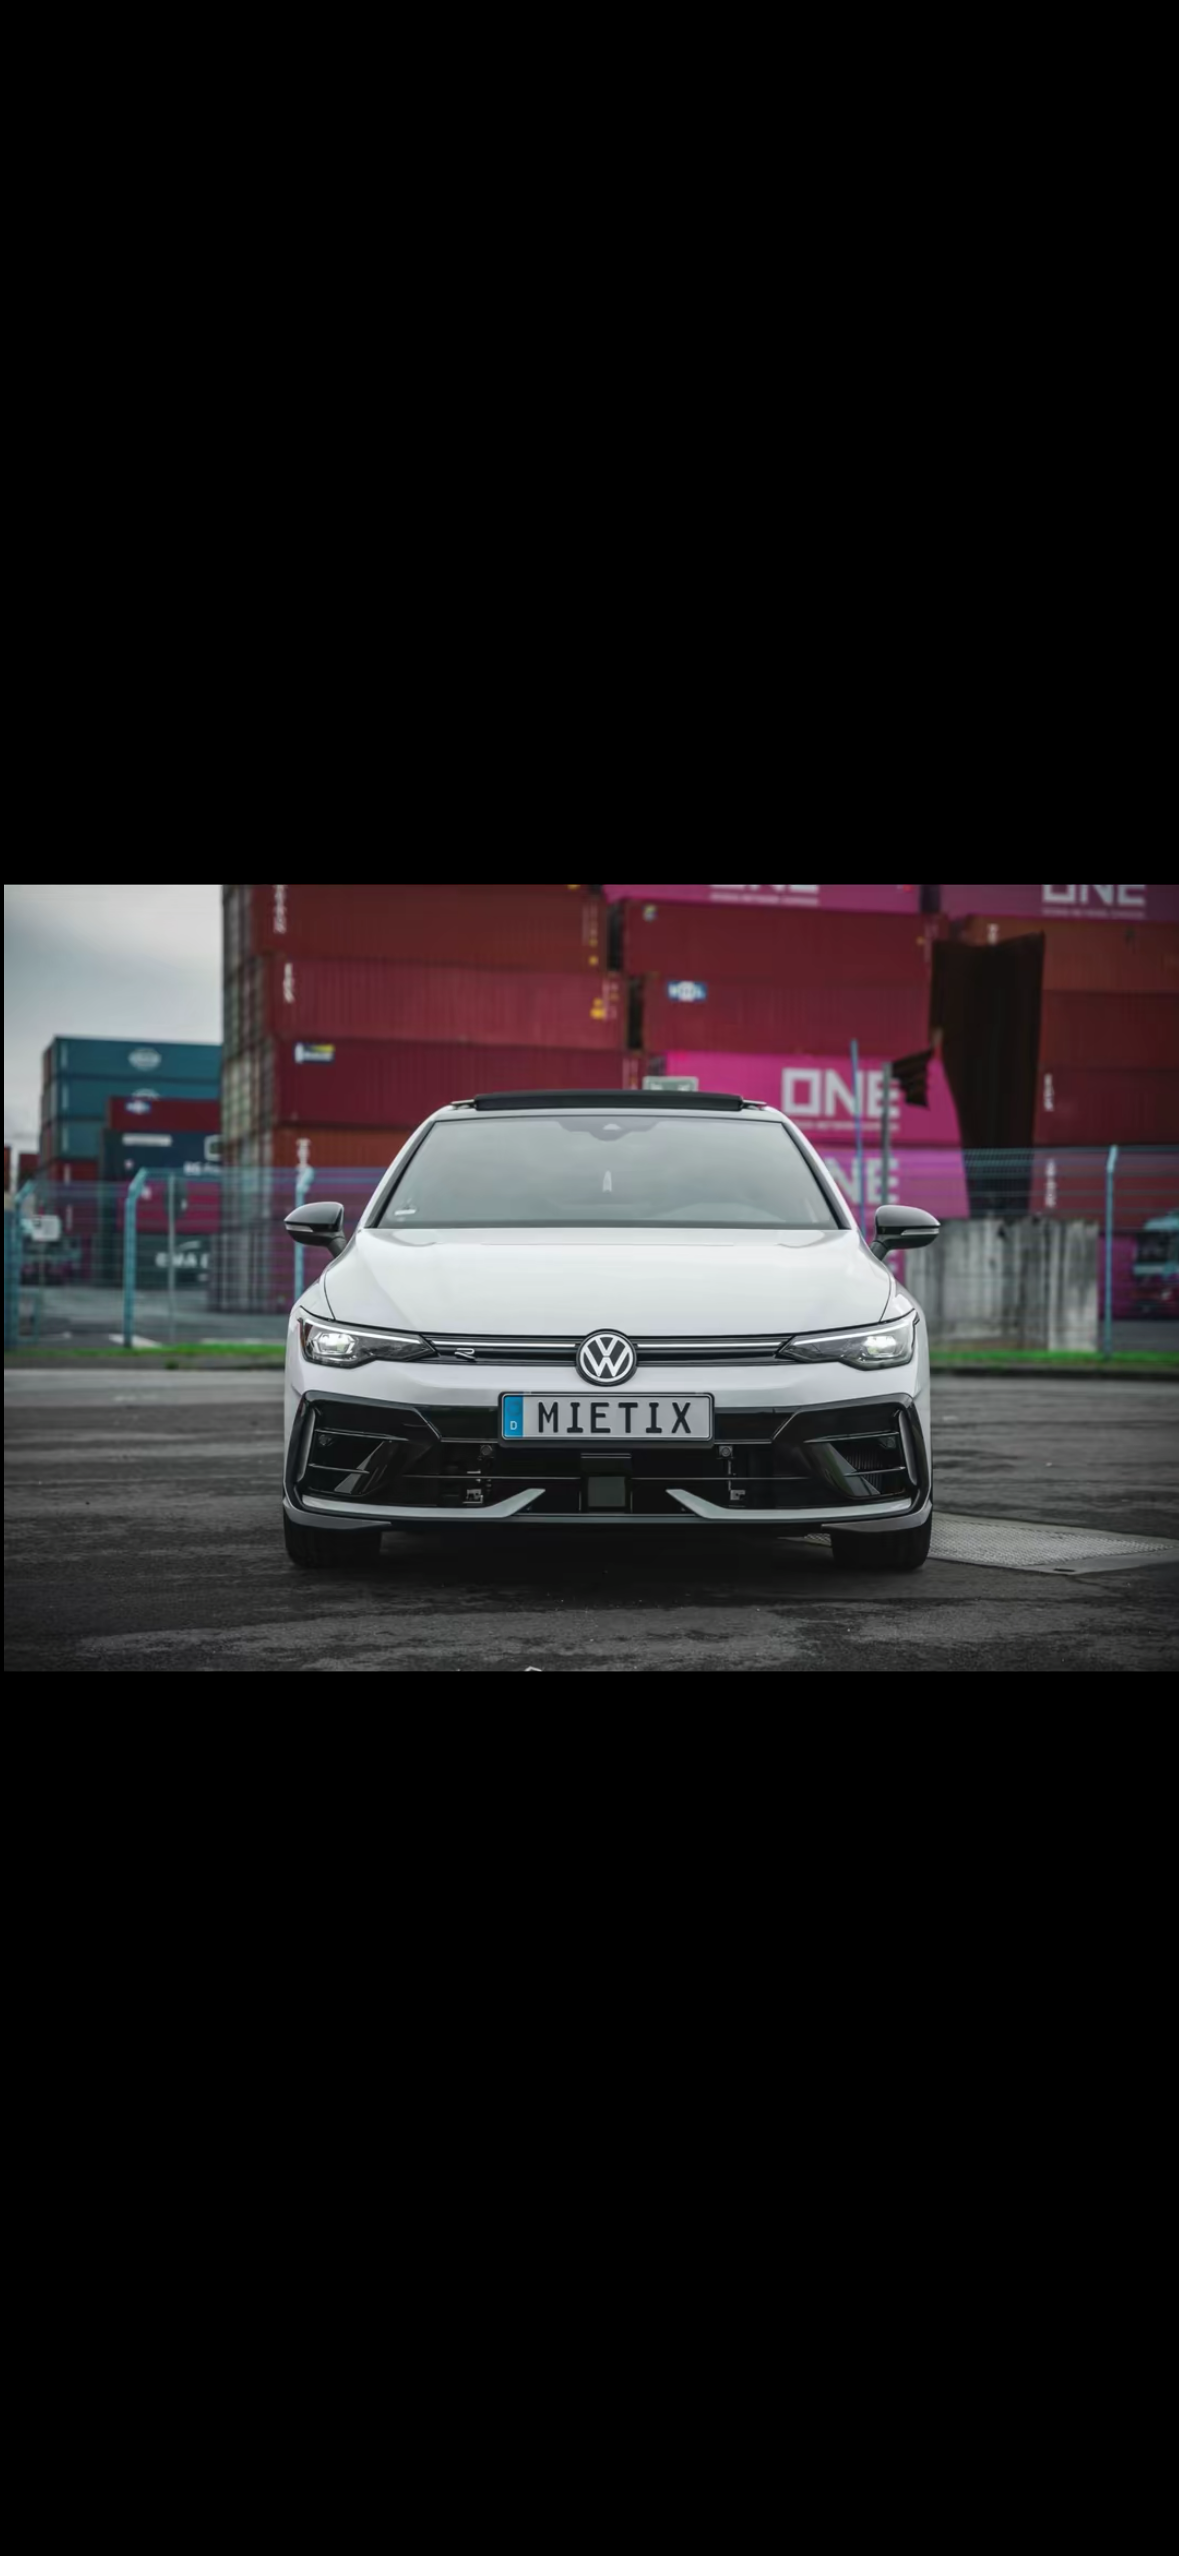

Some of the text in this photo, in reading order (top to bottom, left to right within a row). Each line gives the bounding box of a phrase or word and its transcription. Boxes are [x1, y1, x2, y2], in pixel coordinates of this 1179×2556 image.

[780, 1067, 900, 1118] ONE
[823, 1156, 899, 1206] NE
[510, 1420, 518, 1430] D
[538, 1401, 692, 1434] MIETIX
